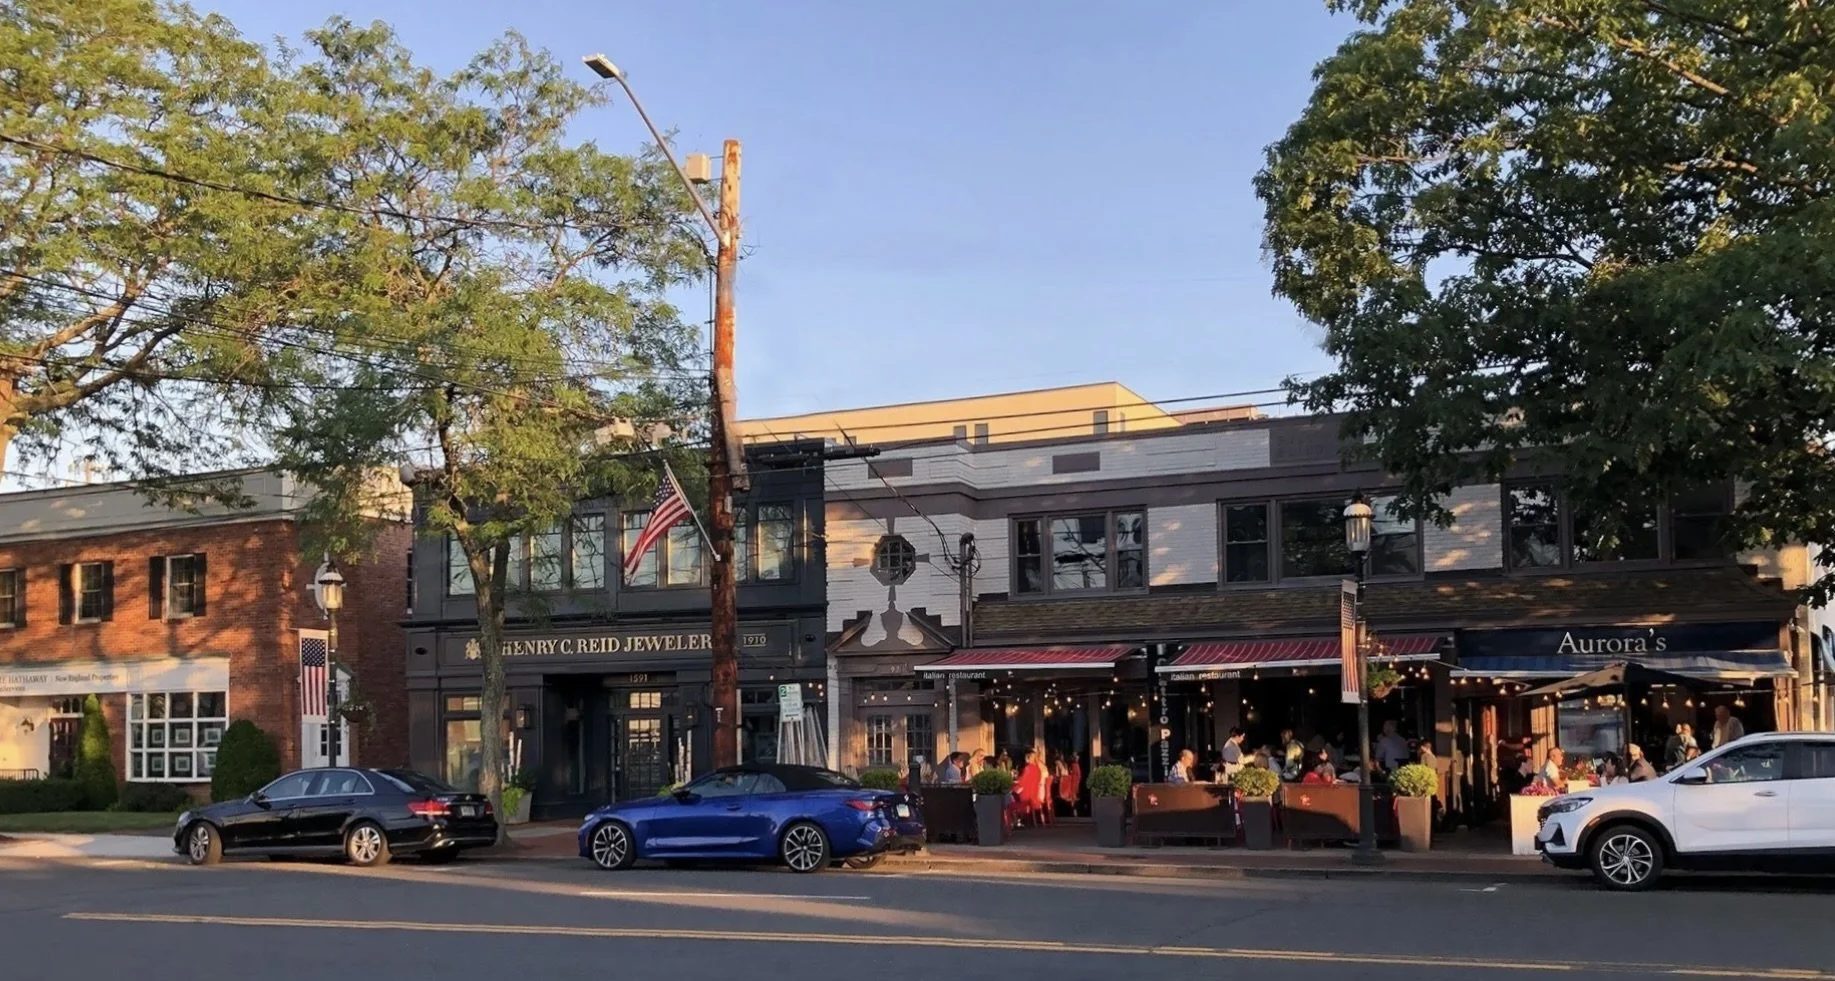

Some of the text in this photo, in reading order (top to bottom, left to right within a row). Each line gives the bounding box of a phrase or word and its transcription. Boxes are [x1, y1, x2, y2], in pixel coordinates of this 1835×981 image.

[501, 634, 713, 656] HENRY C. REID JEWELER
[744, 636, 766, 645] 1910
[1557, 627, 1667, 654] Aurora's
[8, 675, 48, 684] HATHAWAY
[630, 674, 648, 683] 1591
[949, 671, 986, 679] restaurant
[1199, 670, 1240, 680] restaurant
